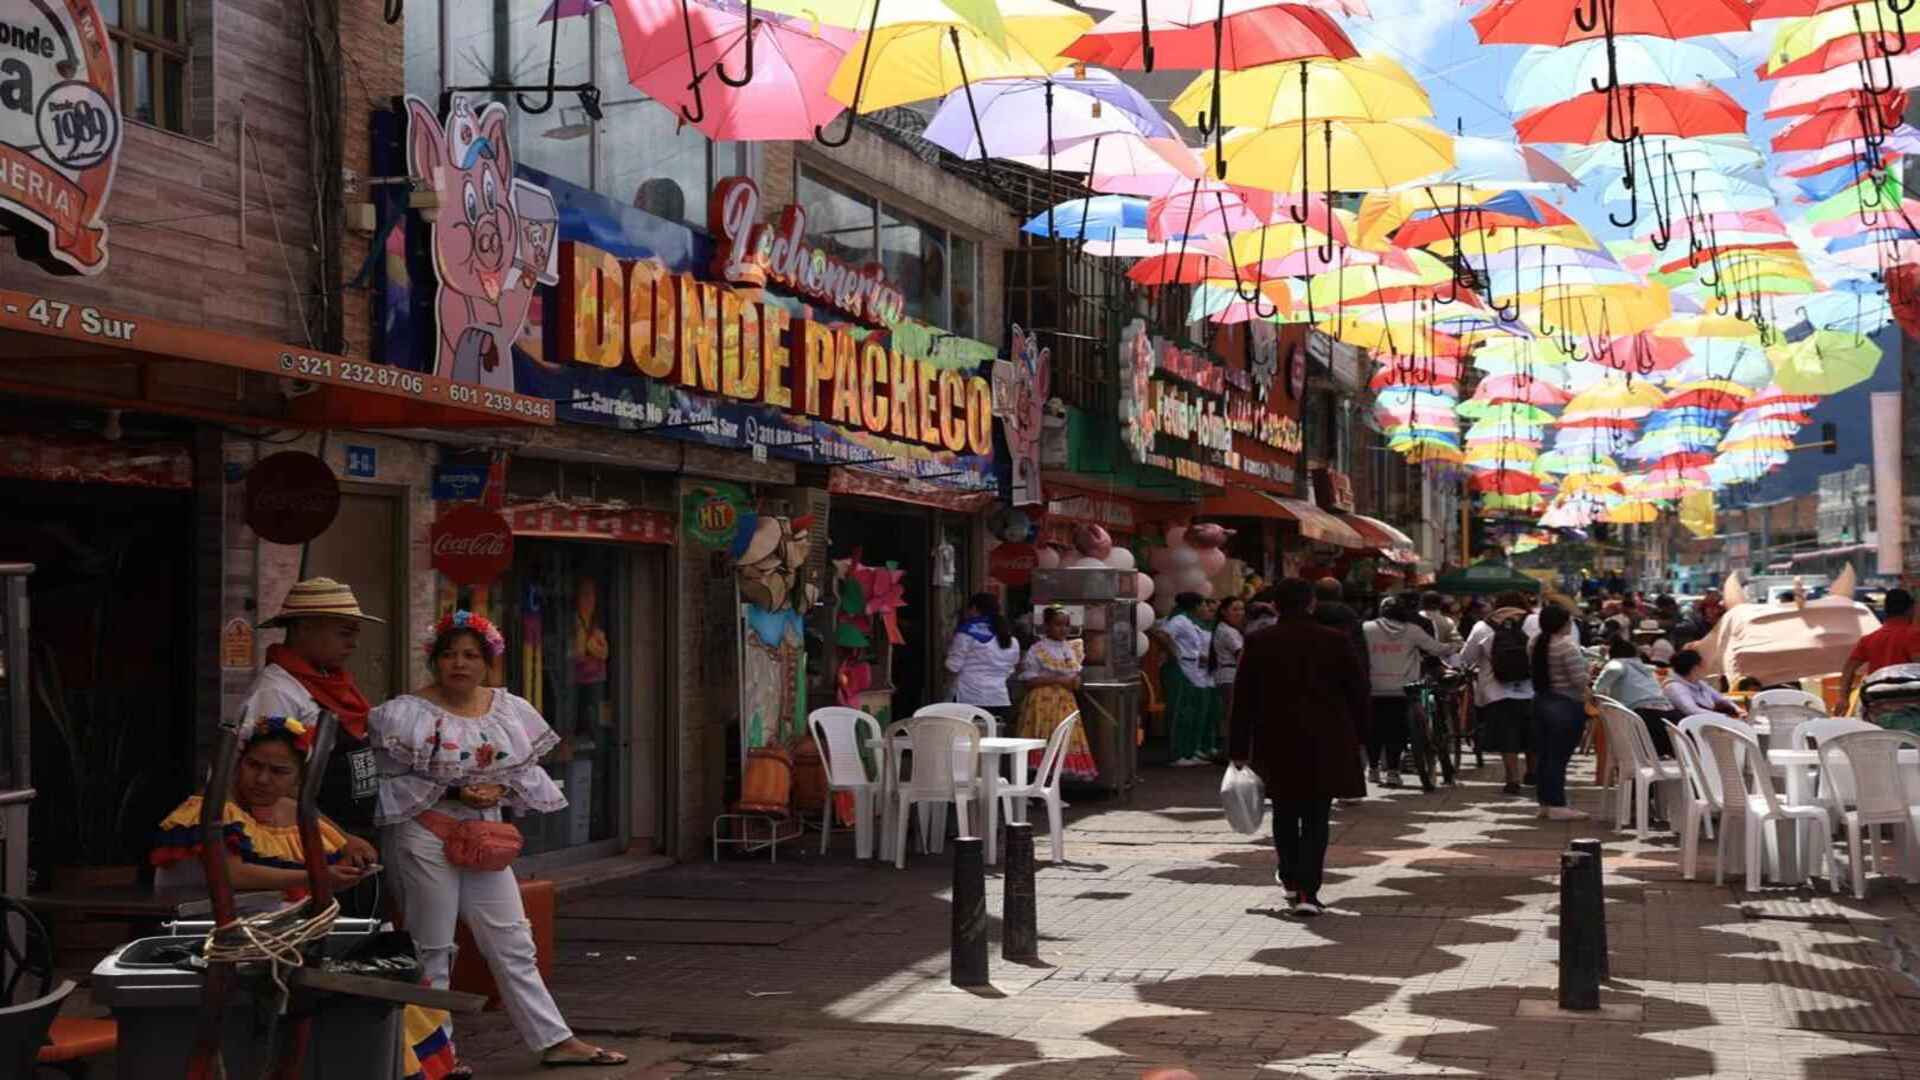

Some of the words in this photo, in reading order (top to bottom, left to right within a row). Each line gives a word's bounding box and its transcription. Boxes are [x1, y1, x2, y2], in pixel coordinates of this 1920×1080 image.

[52, 100, 107, 157] 1989
[29, 299, 70, 328] 47
[81, 307, 136, 340] Sur
[573, 241, 791, 407] DONDE
[804, 319, 992, 456] PACHECO
[298, 355, 333, 377] 321
[449, 384, 478, 404] 601
